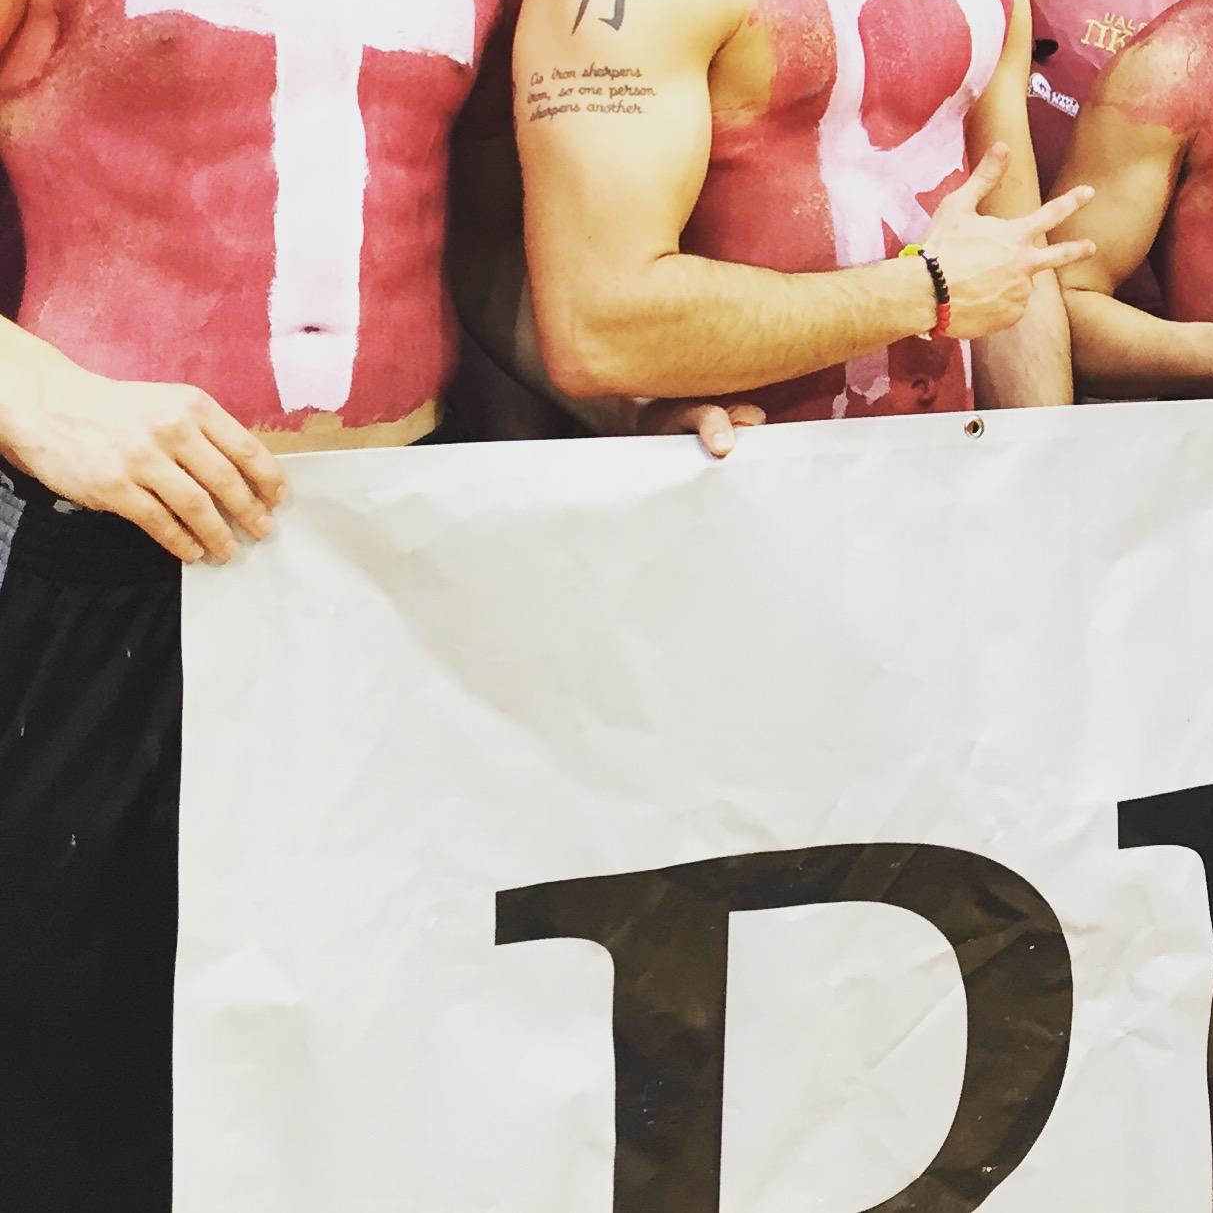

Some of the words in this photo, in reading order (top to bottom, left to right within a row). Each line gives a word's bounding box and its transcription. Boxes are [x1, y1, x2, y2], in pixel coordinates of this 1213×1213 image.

[530, 72, 544, 86] As
[551, 67, 576, 80] iron
[582, 62, 642, 81] sharpens
[527, 91, 551, 104] iron,
[558, 87, 574, 97] so
[578, 87, 603, 96] one
[609, 84, 656, 99] person
[530, 101, 581, 121] sharpens
